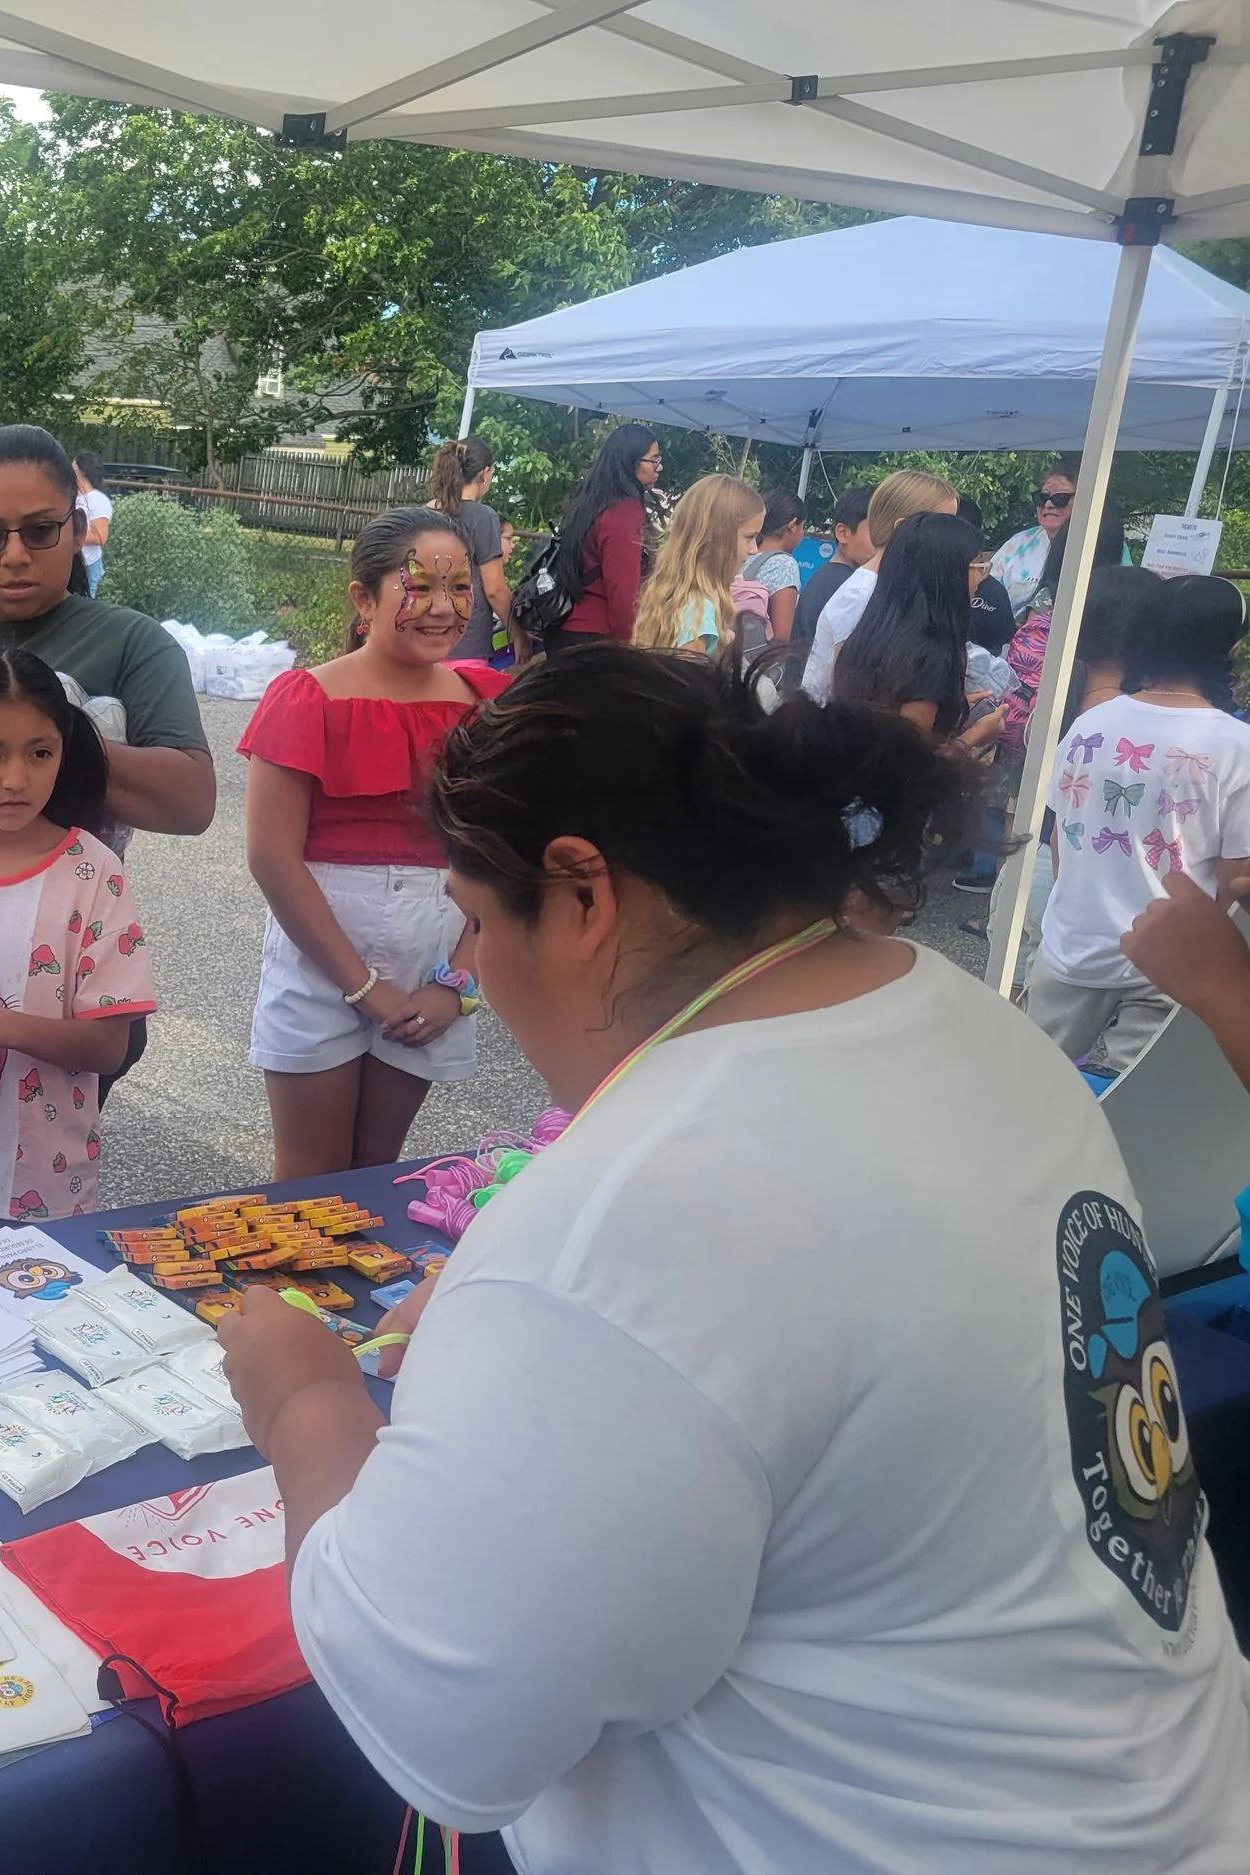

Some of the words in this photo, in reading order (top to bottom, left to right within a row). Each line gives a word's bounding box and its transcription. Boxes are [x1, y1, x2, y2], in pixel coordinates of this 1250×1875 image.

[971, 597, 996, 612] Diner
[1082, 1202, 1104, 1230] OF
[1062, 1209, 1089, 1283] VOICE
[1065, 1286, 1087, 1371] ONE
[126, 1529, 228, 1561] VOICE
[1082, 1451, 1170, 1615] Together
[21, 1681, 33, 1701] BUDDY
